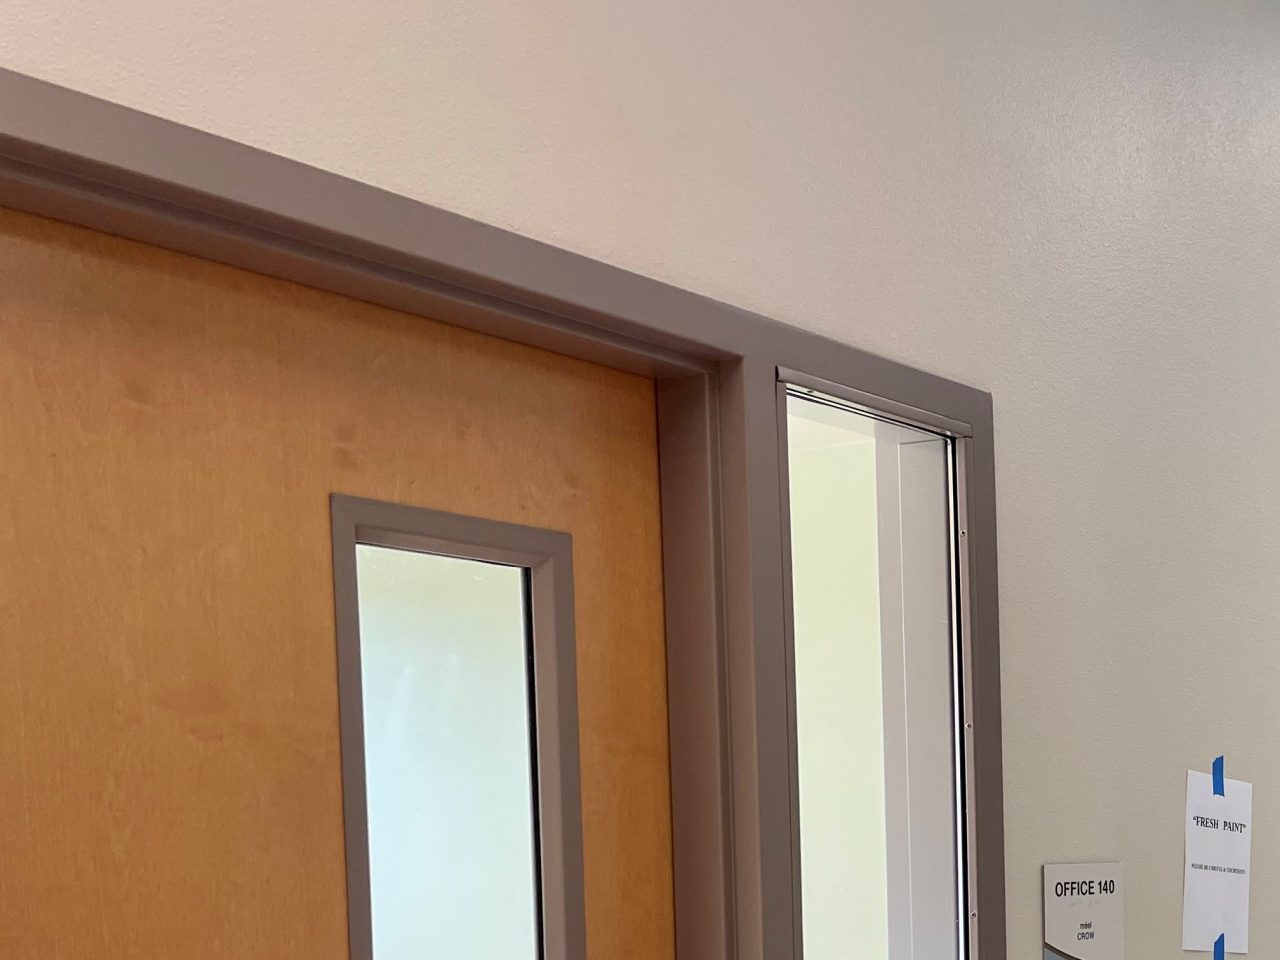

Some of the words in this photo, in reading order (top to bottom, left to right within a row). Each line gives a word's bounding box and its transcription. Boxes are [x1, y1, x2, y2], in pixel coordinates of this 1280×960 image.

[1055, 880, 1095, 897] OFFICE
[1098, 879, 1115, 894] 140
[1077, 931, 1095, 941] CROW
